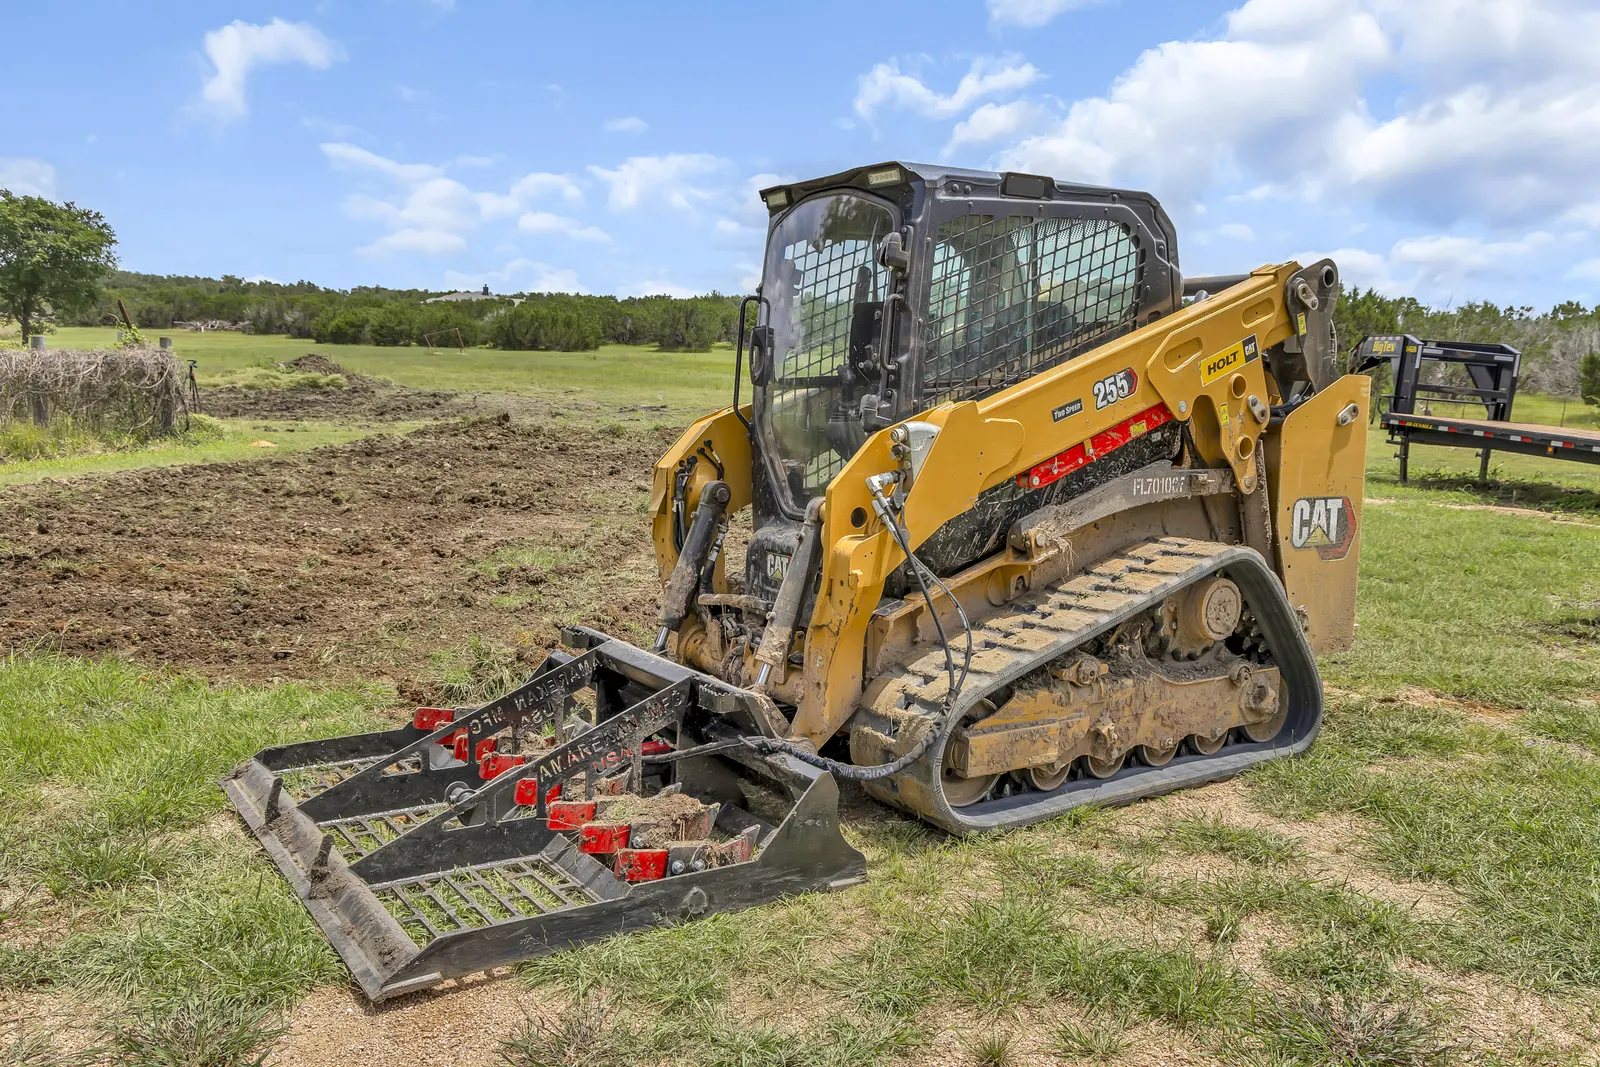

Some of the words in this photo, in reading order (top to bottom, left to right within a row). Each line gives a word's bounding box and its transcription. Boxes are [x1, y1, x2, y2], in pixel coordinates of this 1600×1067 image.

[1207, 350, 1239, 376] HOLT
[1244, 341, 1256, 356] CAT
[1093, 371, 1129, 410] 255
[1292, 498, 1343, 548] CAT
[767, 553, 789, 579] CAT
[592, 743, 635, 775] USA
